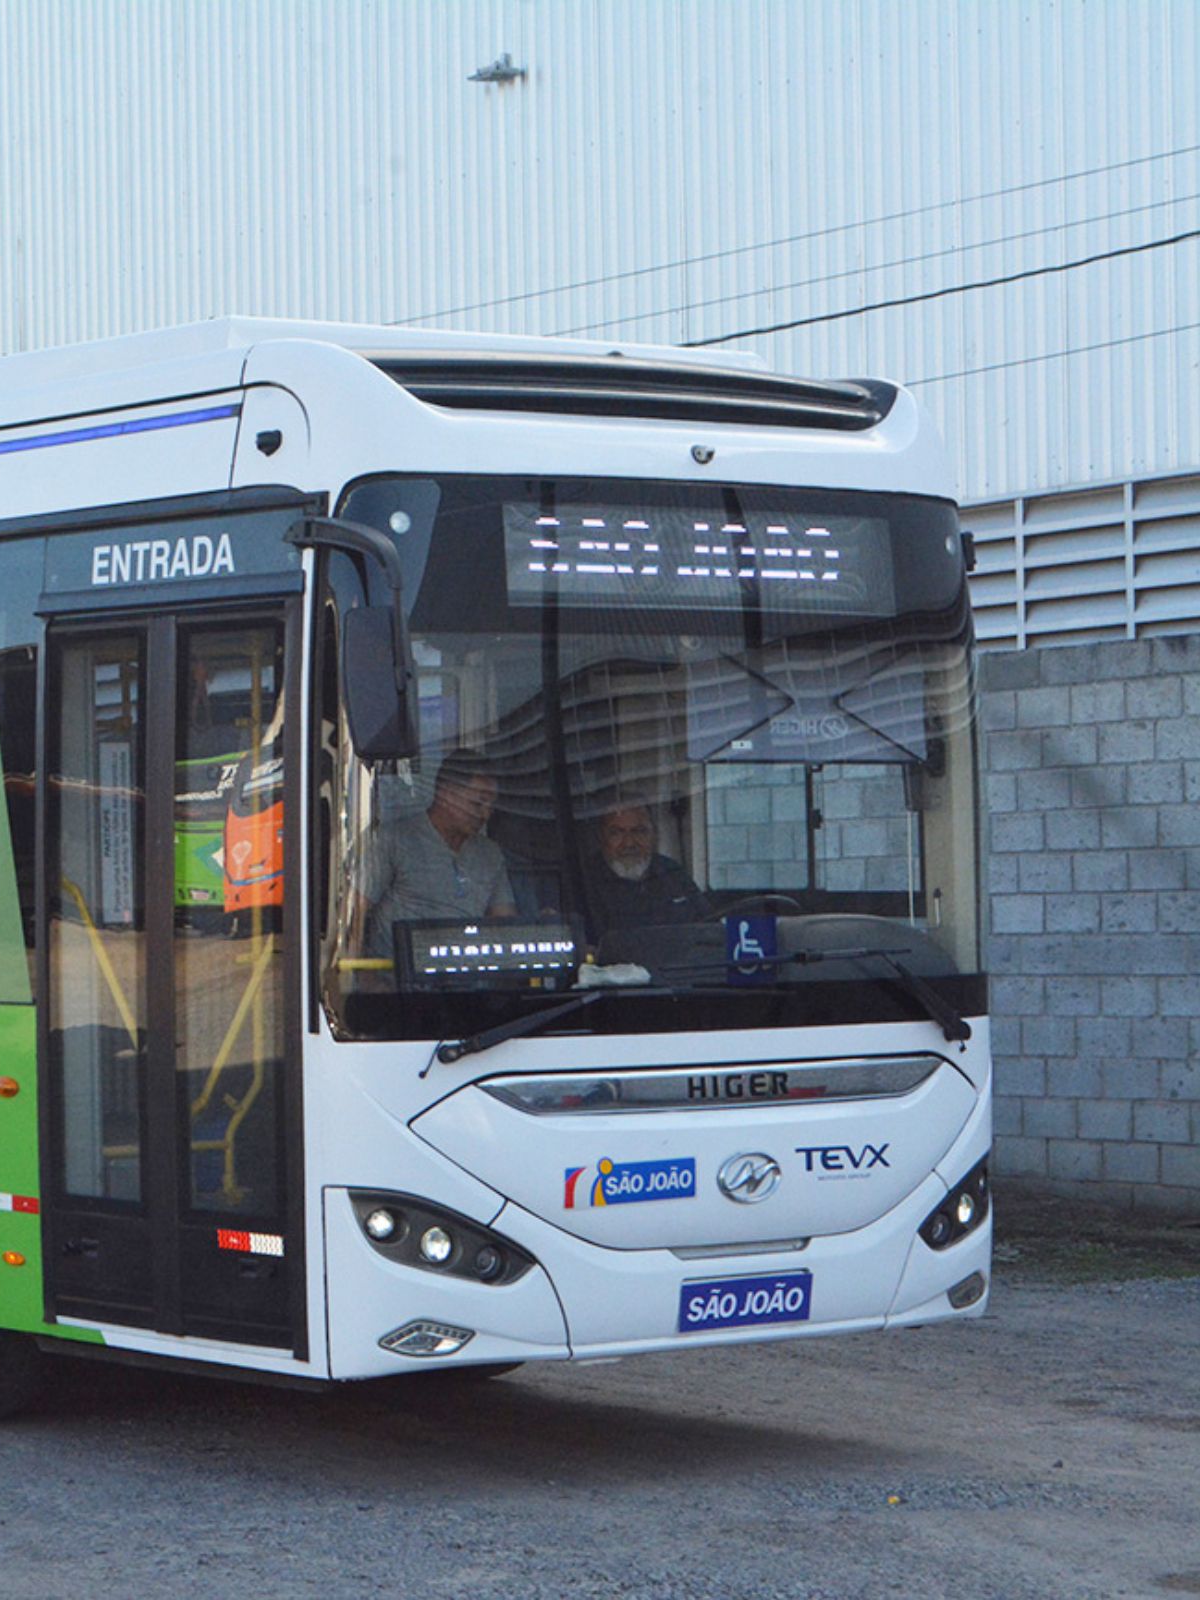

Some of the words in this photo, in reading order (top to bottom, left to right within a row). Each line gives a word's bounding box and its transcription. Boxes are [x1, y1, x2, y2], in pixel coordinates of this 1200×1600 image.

[92, 533, 235, 584] ENTRADA
[687, 1071, 789, 1098] HIGER
[795, 1143, 891, 1172] TEVX
[605, 1171, 643, 1195] SÃO
[644, 1165, 692, 1192] JOÃO
[687, 1284, 737, 1323] SÃO
[738, 1279, 804, 1317] JOÃO
